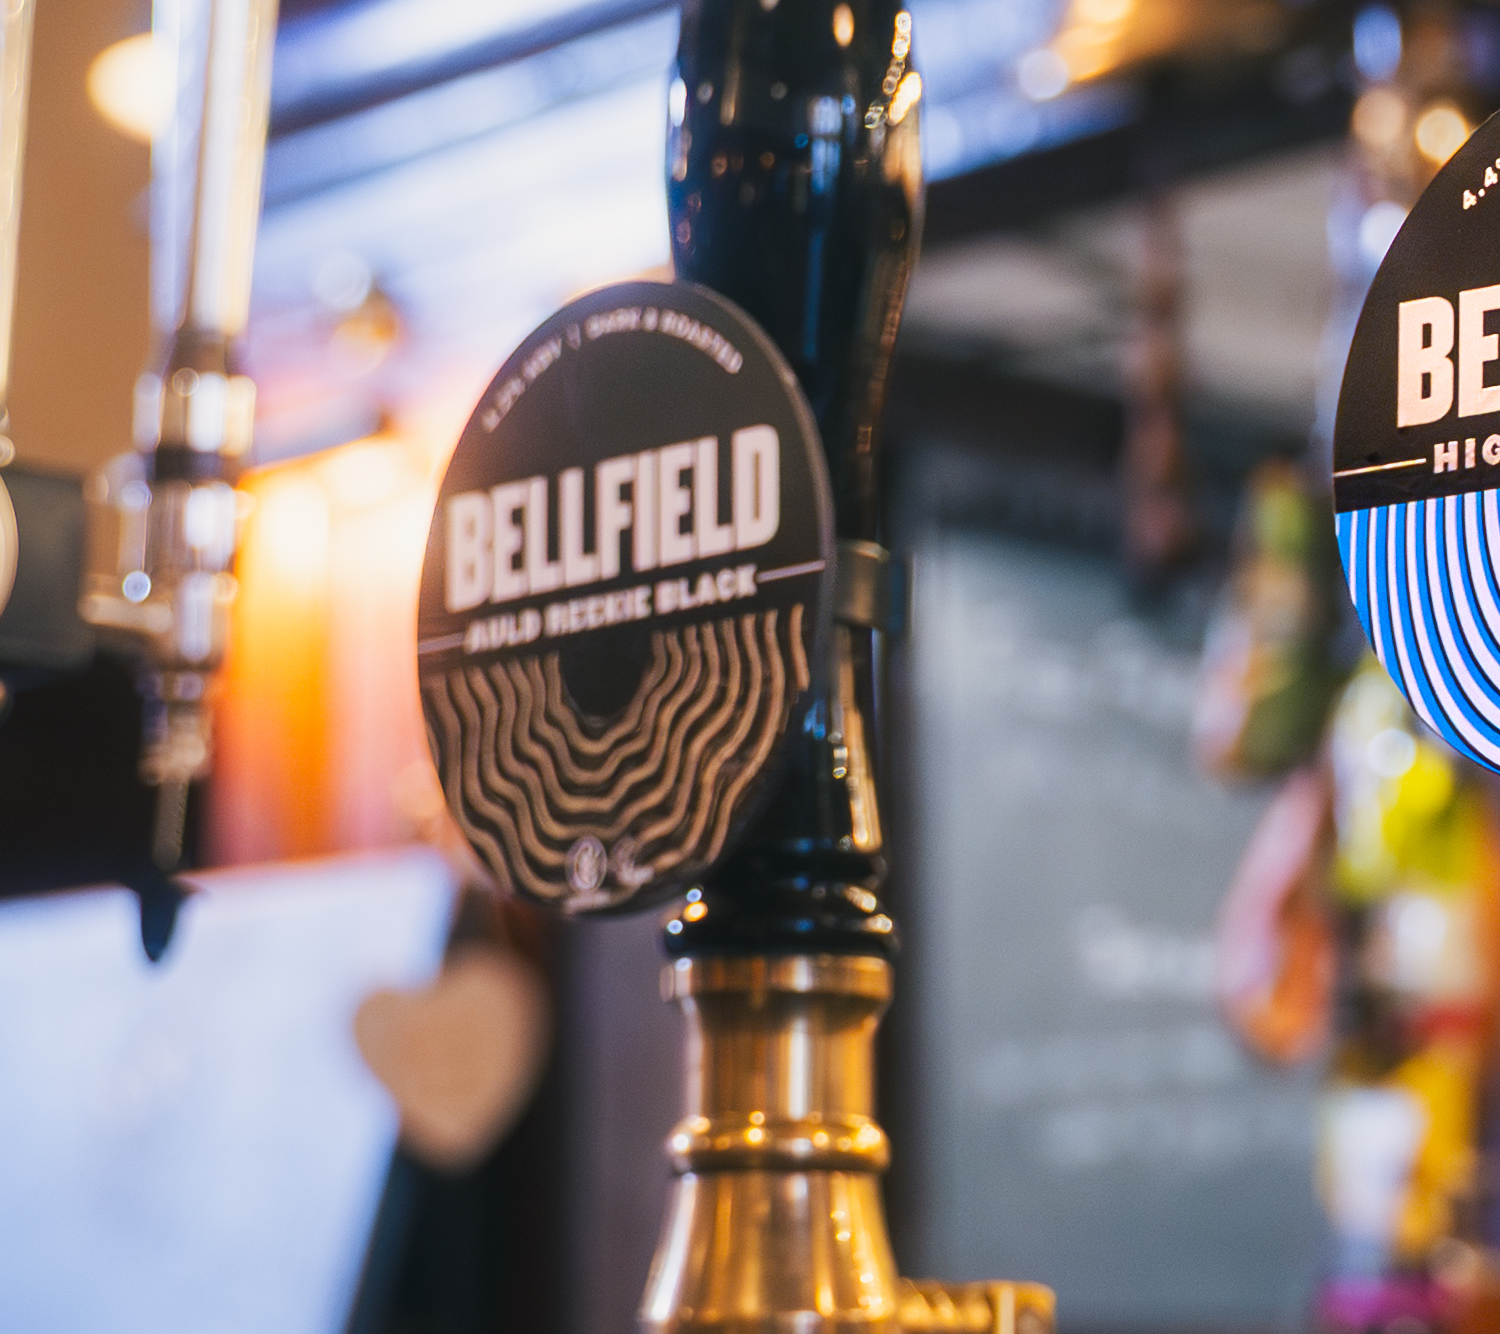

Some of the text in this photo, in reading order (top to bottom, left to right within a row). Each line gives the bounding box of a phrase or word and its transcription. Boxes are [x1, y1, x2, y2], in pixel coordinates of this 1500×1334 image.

[445, 422, 780, 614] BELLFIELD
[463, 608, 542, 654] AULD
[653, 564, 758, 615] BLACK
